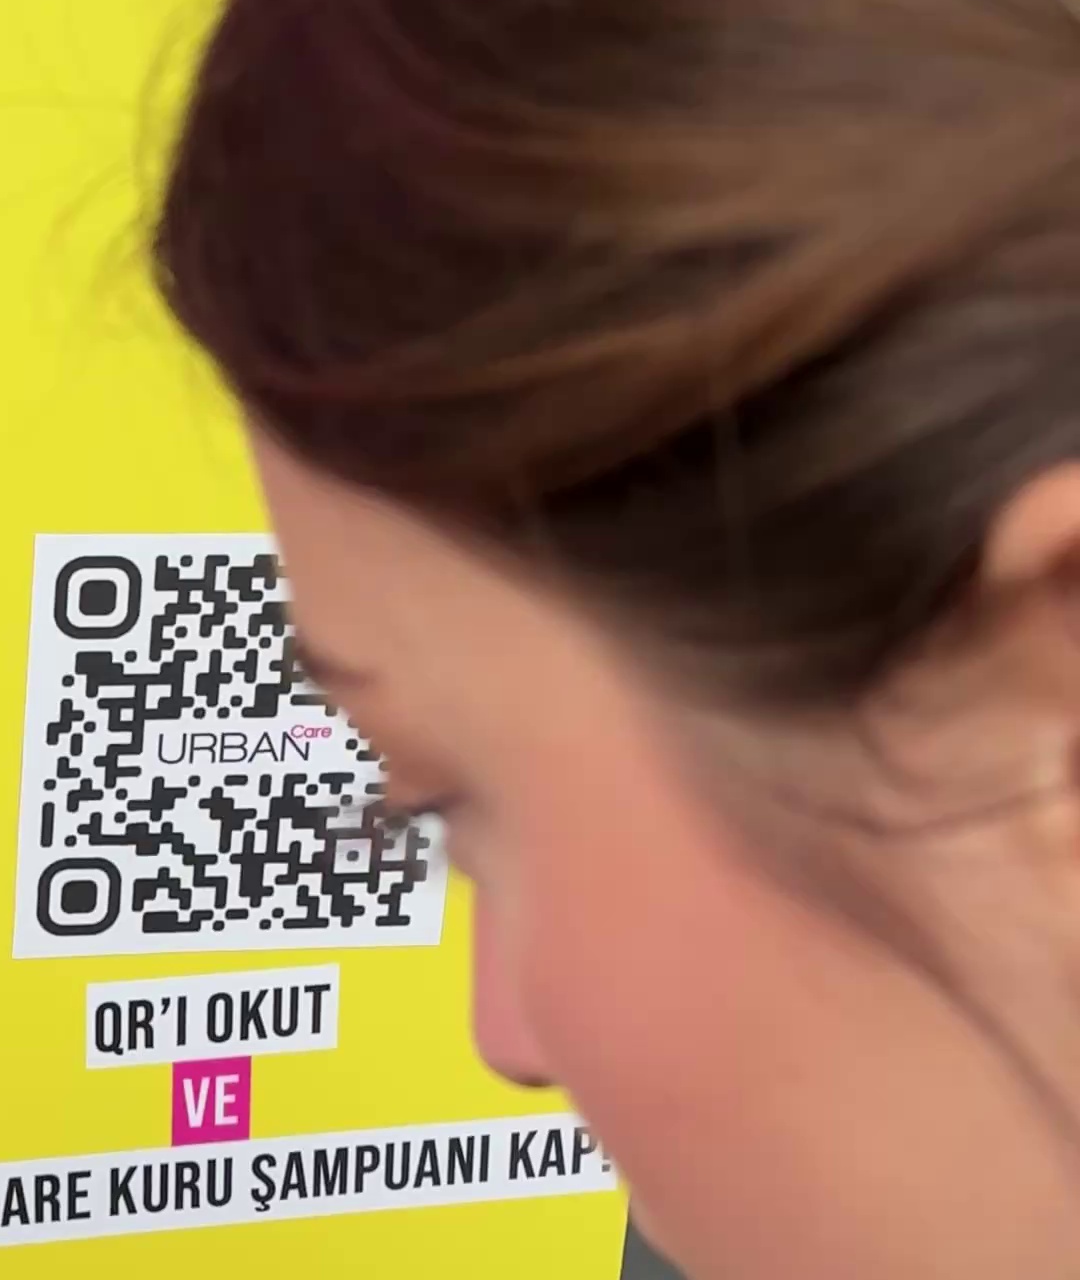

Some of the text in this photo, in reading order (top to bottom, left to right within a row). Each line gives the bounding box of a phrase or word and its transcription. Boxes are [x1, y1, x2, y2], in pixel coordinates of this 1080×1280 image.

[157, 724, 333, 765] URBAN Care
[94, 983, 331, 1056] QR’I OKUT
[182, 1073, 240, 1128] VE
[109, 1157, 234, 1217] KURU
[250, 1134, 491, 1212] ŞAMPUANI
